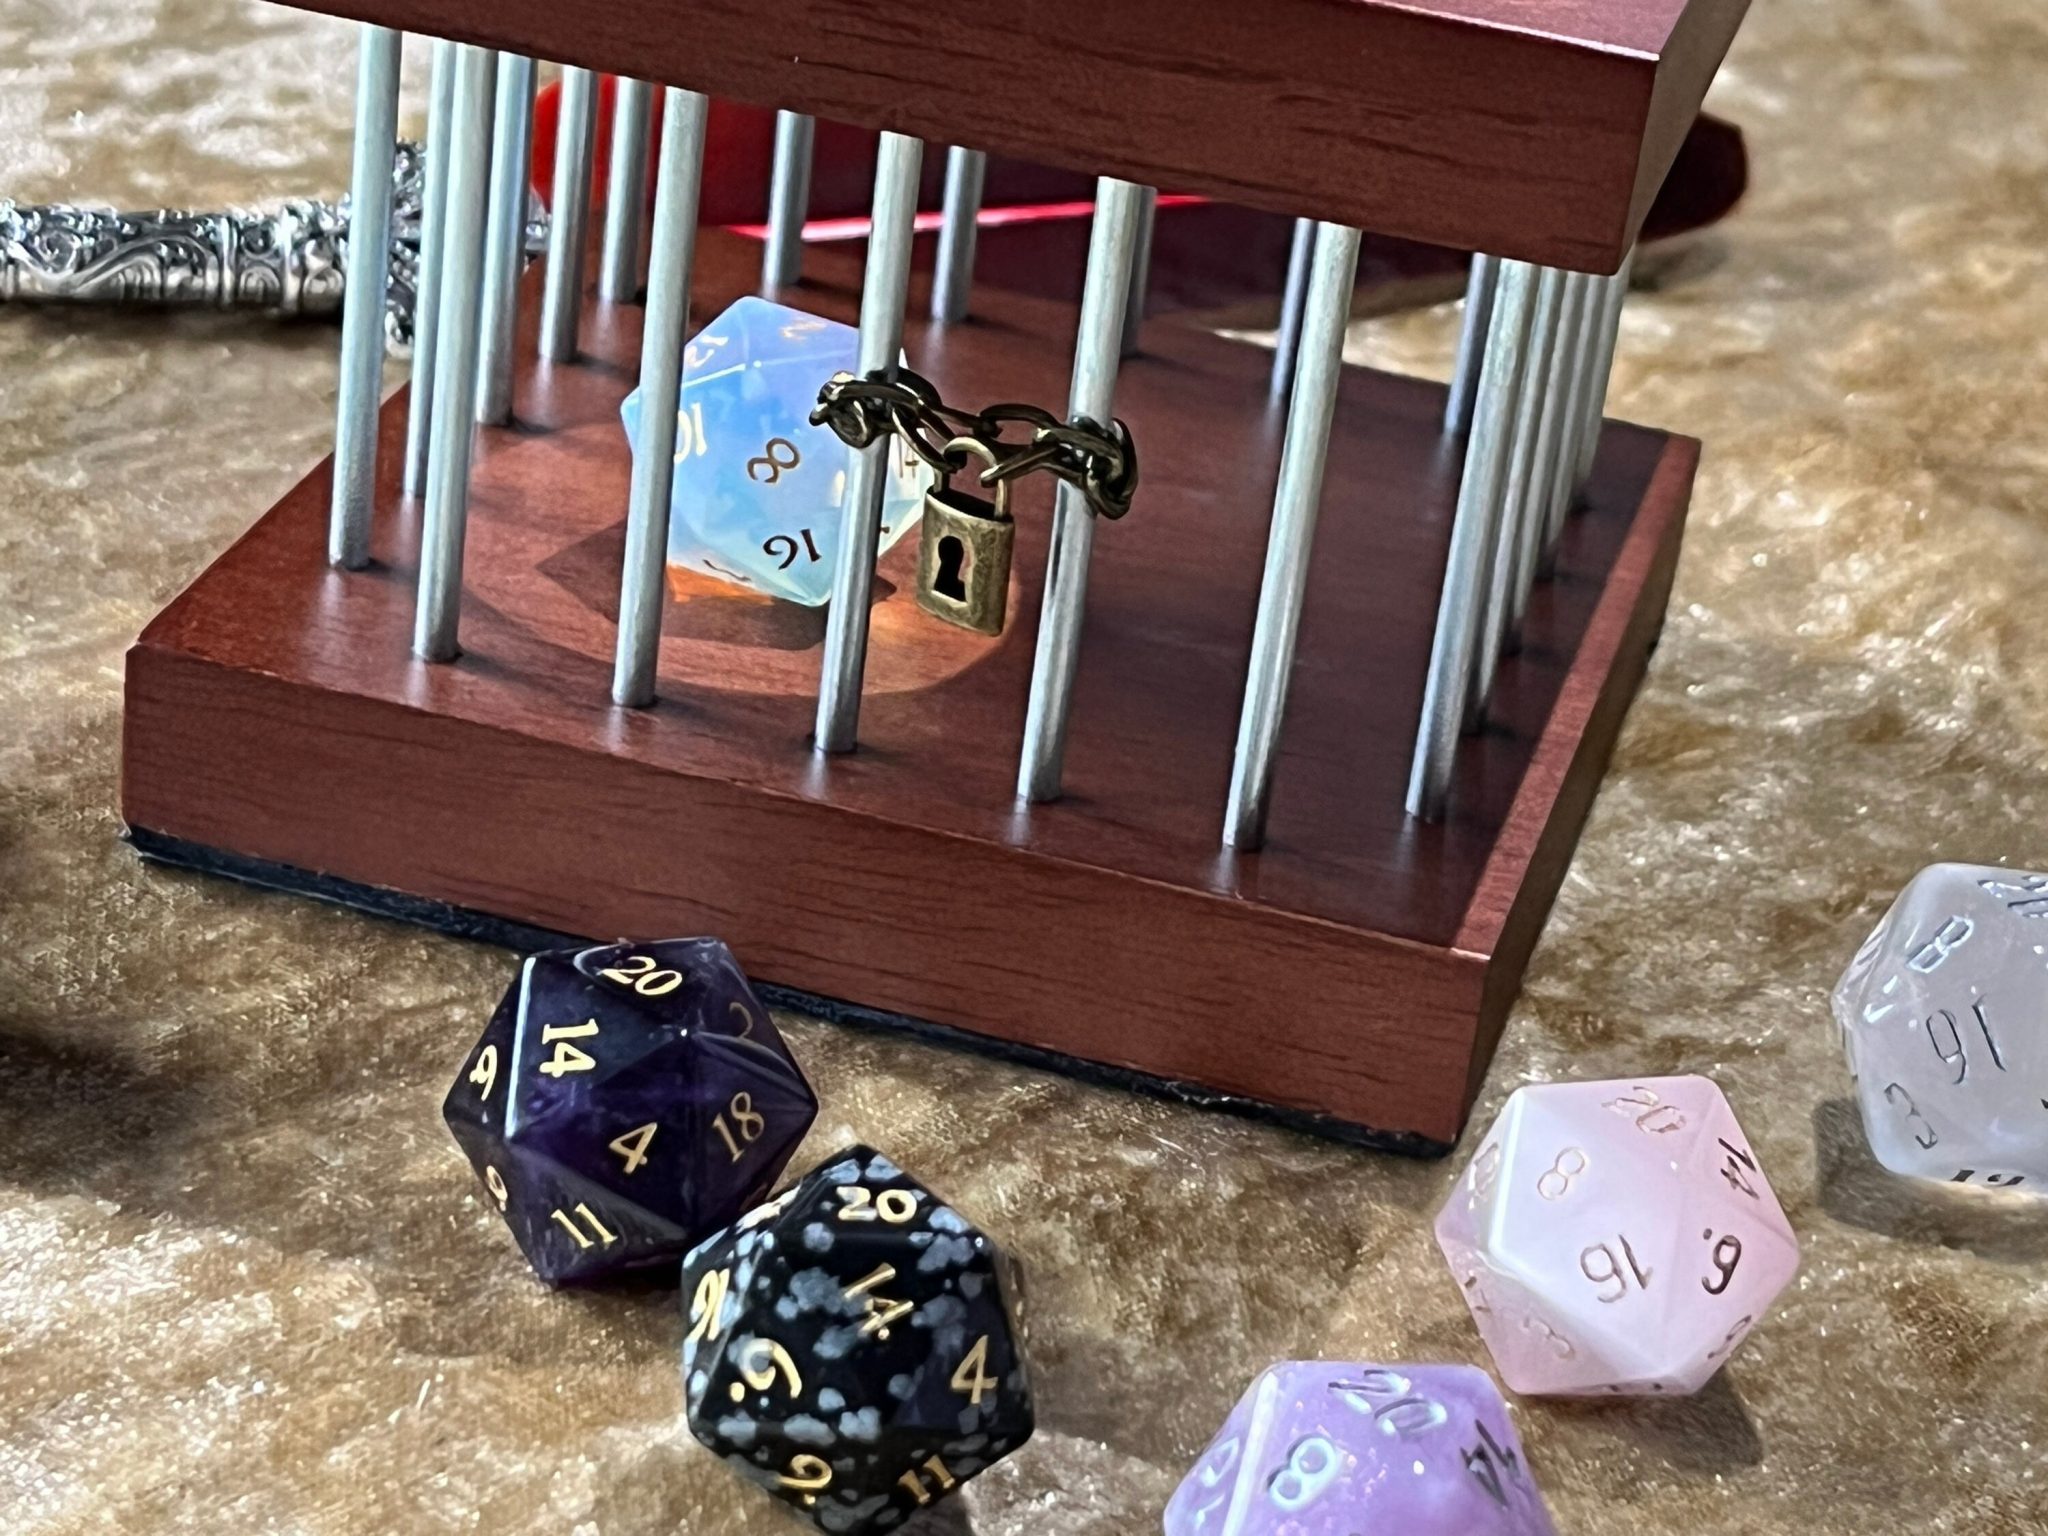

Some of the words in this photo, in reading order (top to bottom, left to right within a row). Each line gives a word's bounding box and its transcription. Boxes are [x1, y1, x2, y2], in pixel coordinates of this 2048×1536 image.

[747, 437, 800, 483] 8
[762, 528, 822, 570] 16
[602, 955, 683, 996] 20
[541, 1018, 600, 1078] 14
[608, 1121, 658, 1174] 4
[711, 1091, 765, 1164] 18
[1537, 1146, 1588, 1201] 8
[551, 1202, 618, 1249] 11
[835, 1186, 918, 1223] 20
[1580, 1234, 1653, 1303] 16
[842, 1262, 914, 1341] 14
[951, 1334, 999, 1405] 4
[1327, 1368, 1448, 1437] 20
[898, 1454, 955, 1504] 11
[1267, 1432, 1340, 1513] 8
